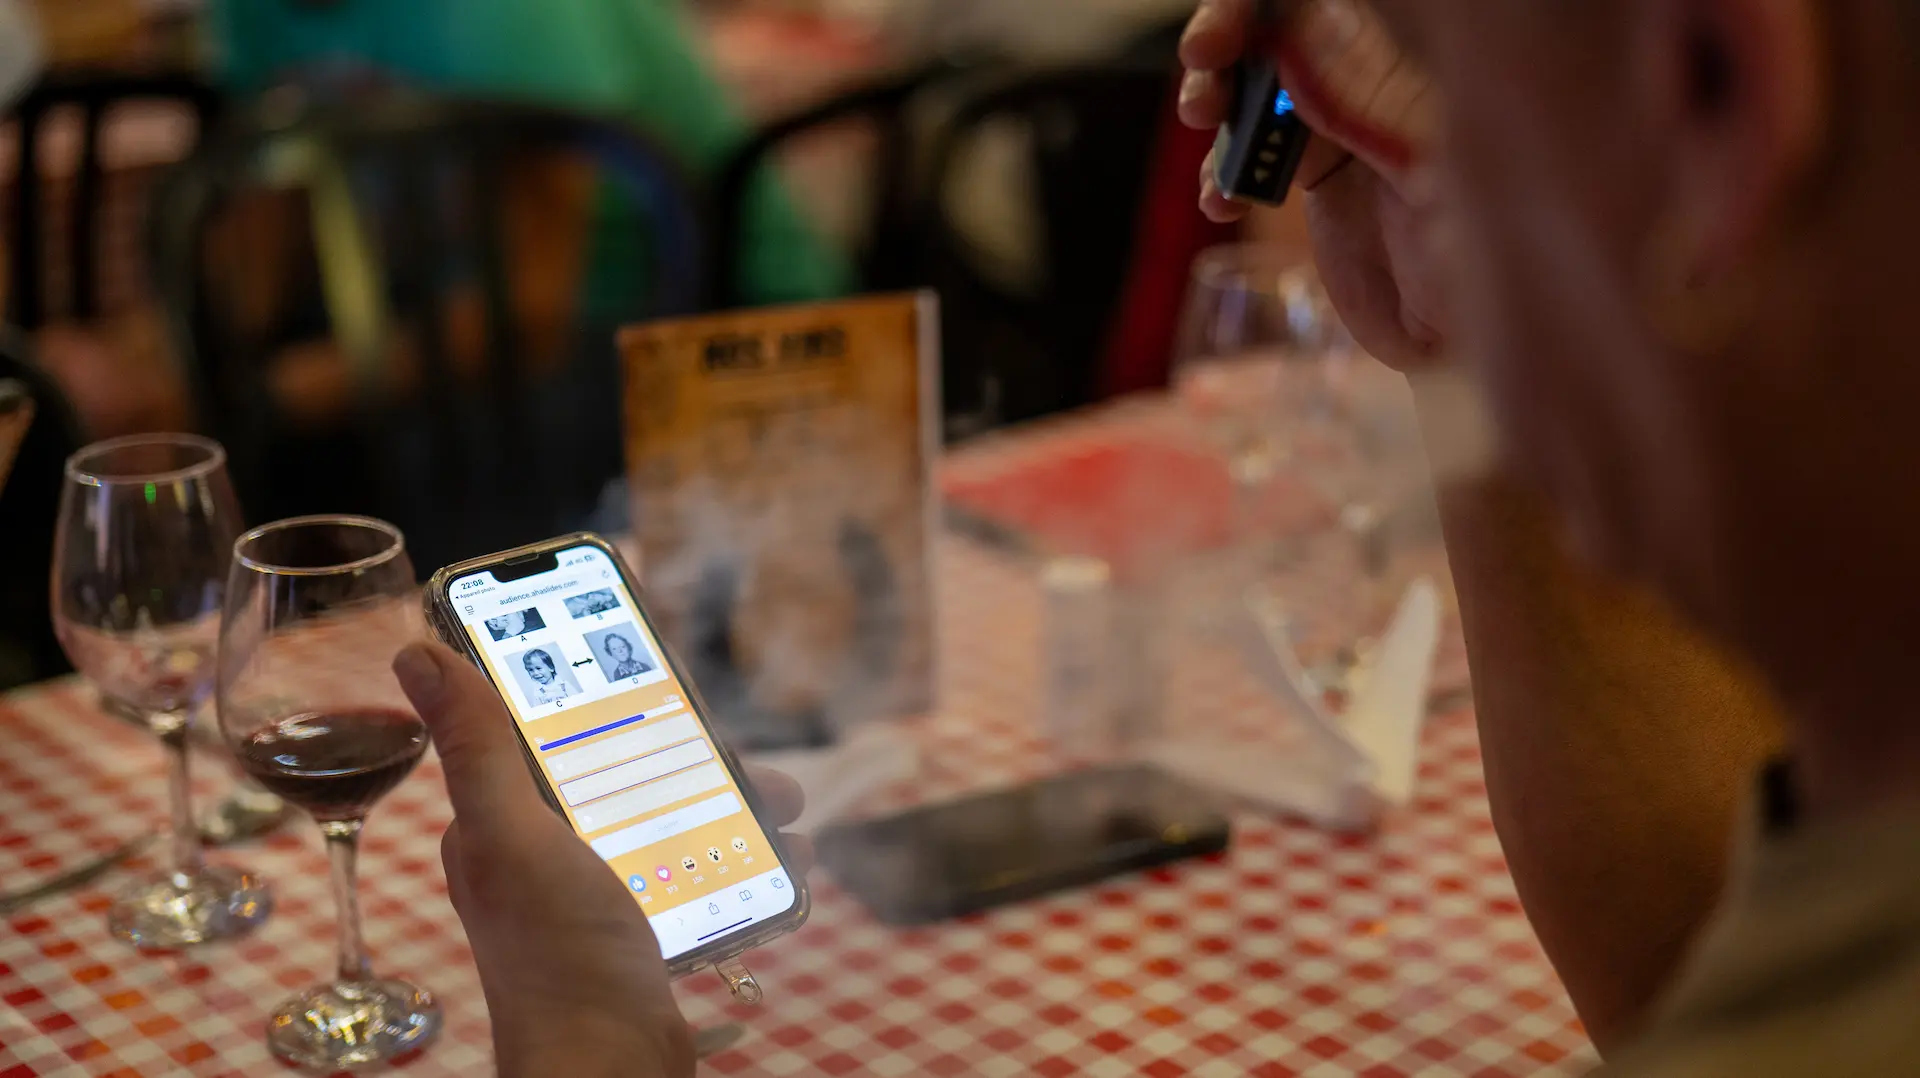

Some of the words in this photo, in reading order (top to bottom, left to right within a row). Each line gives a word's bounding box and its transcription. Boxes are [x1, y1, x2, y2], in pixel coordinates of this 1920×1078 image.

[460, 578, 484, 590] 22:08
[459, 589, 481, 599] Appareil
[482, 585, 496, 594] photo
[499, 579, 578, 605] audience.ahaslides.com
[520, 635, 527, 643] A
[632, 677, 639, 685] D
[556, 700, 563, 708] C
